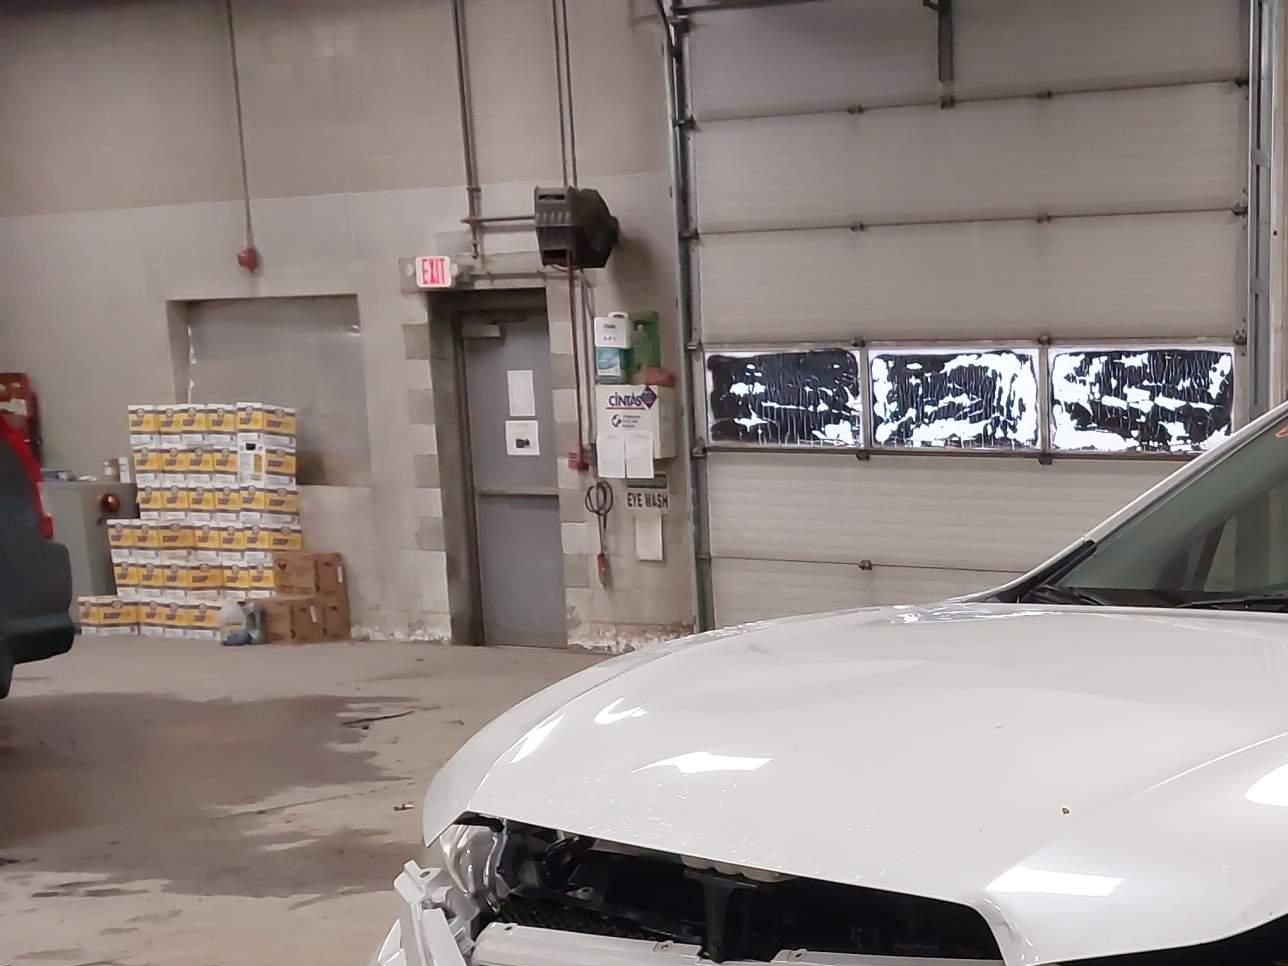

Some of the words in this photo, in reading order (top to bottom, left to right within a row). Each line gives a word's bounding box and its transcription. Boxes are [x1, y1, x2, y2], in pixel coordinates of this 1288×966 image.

[421, 258, 445, 285] EXIT
[608, 392, 642, 407] CINTAS
[627, 492, 643, 508] EYE
[644, 492, 669, 509] WASH
